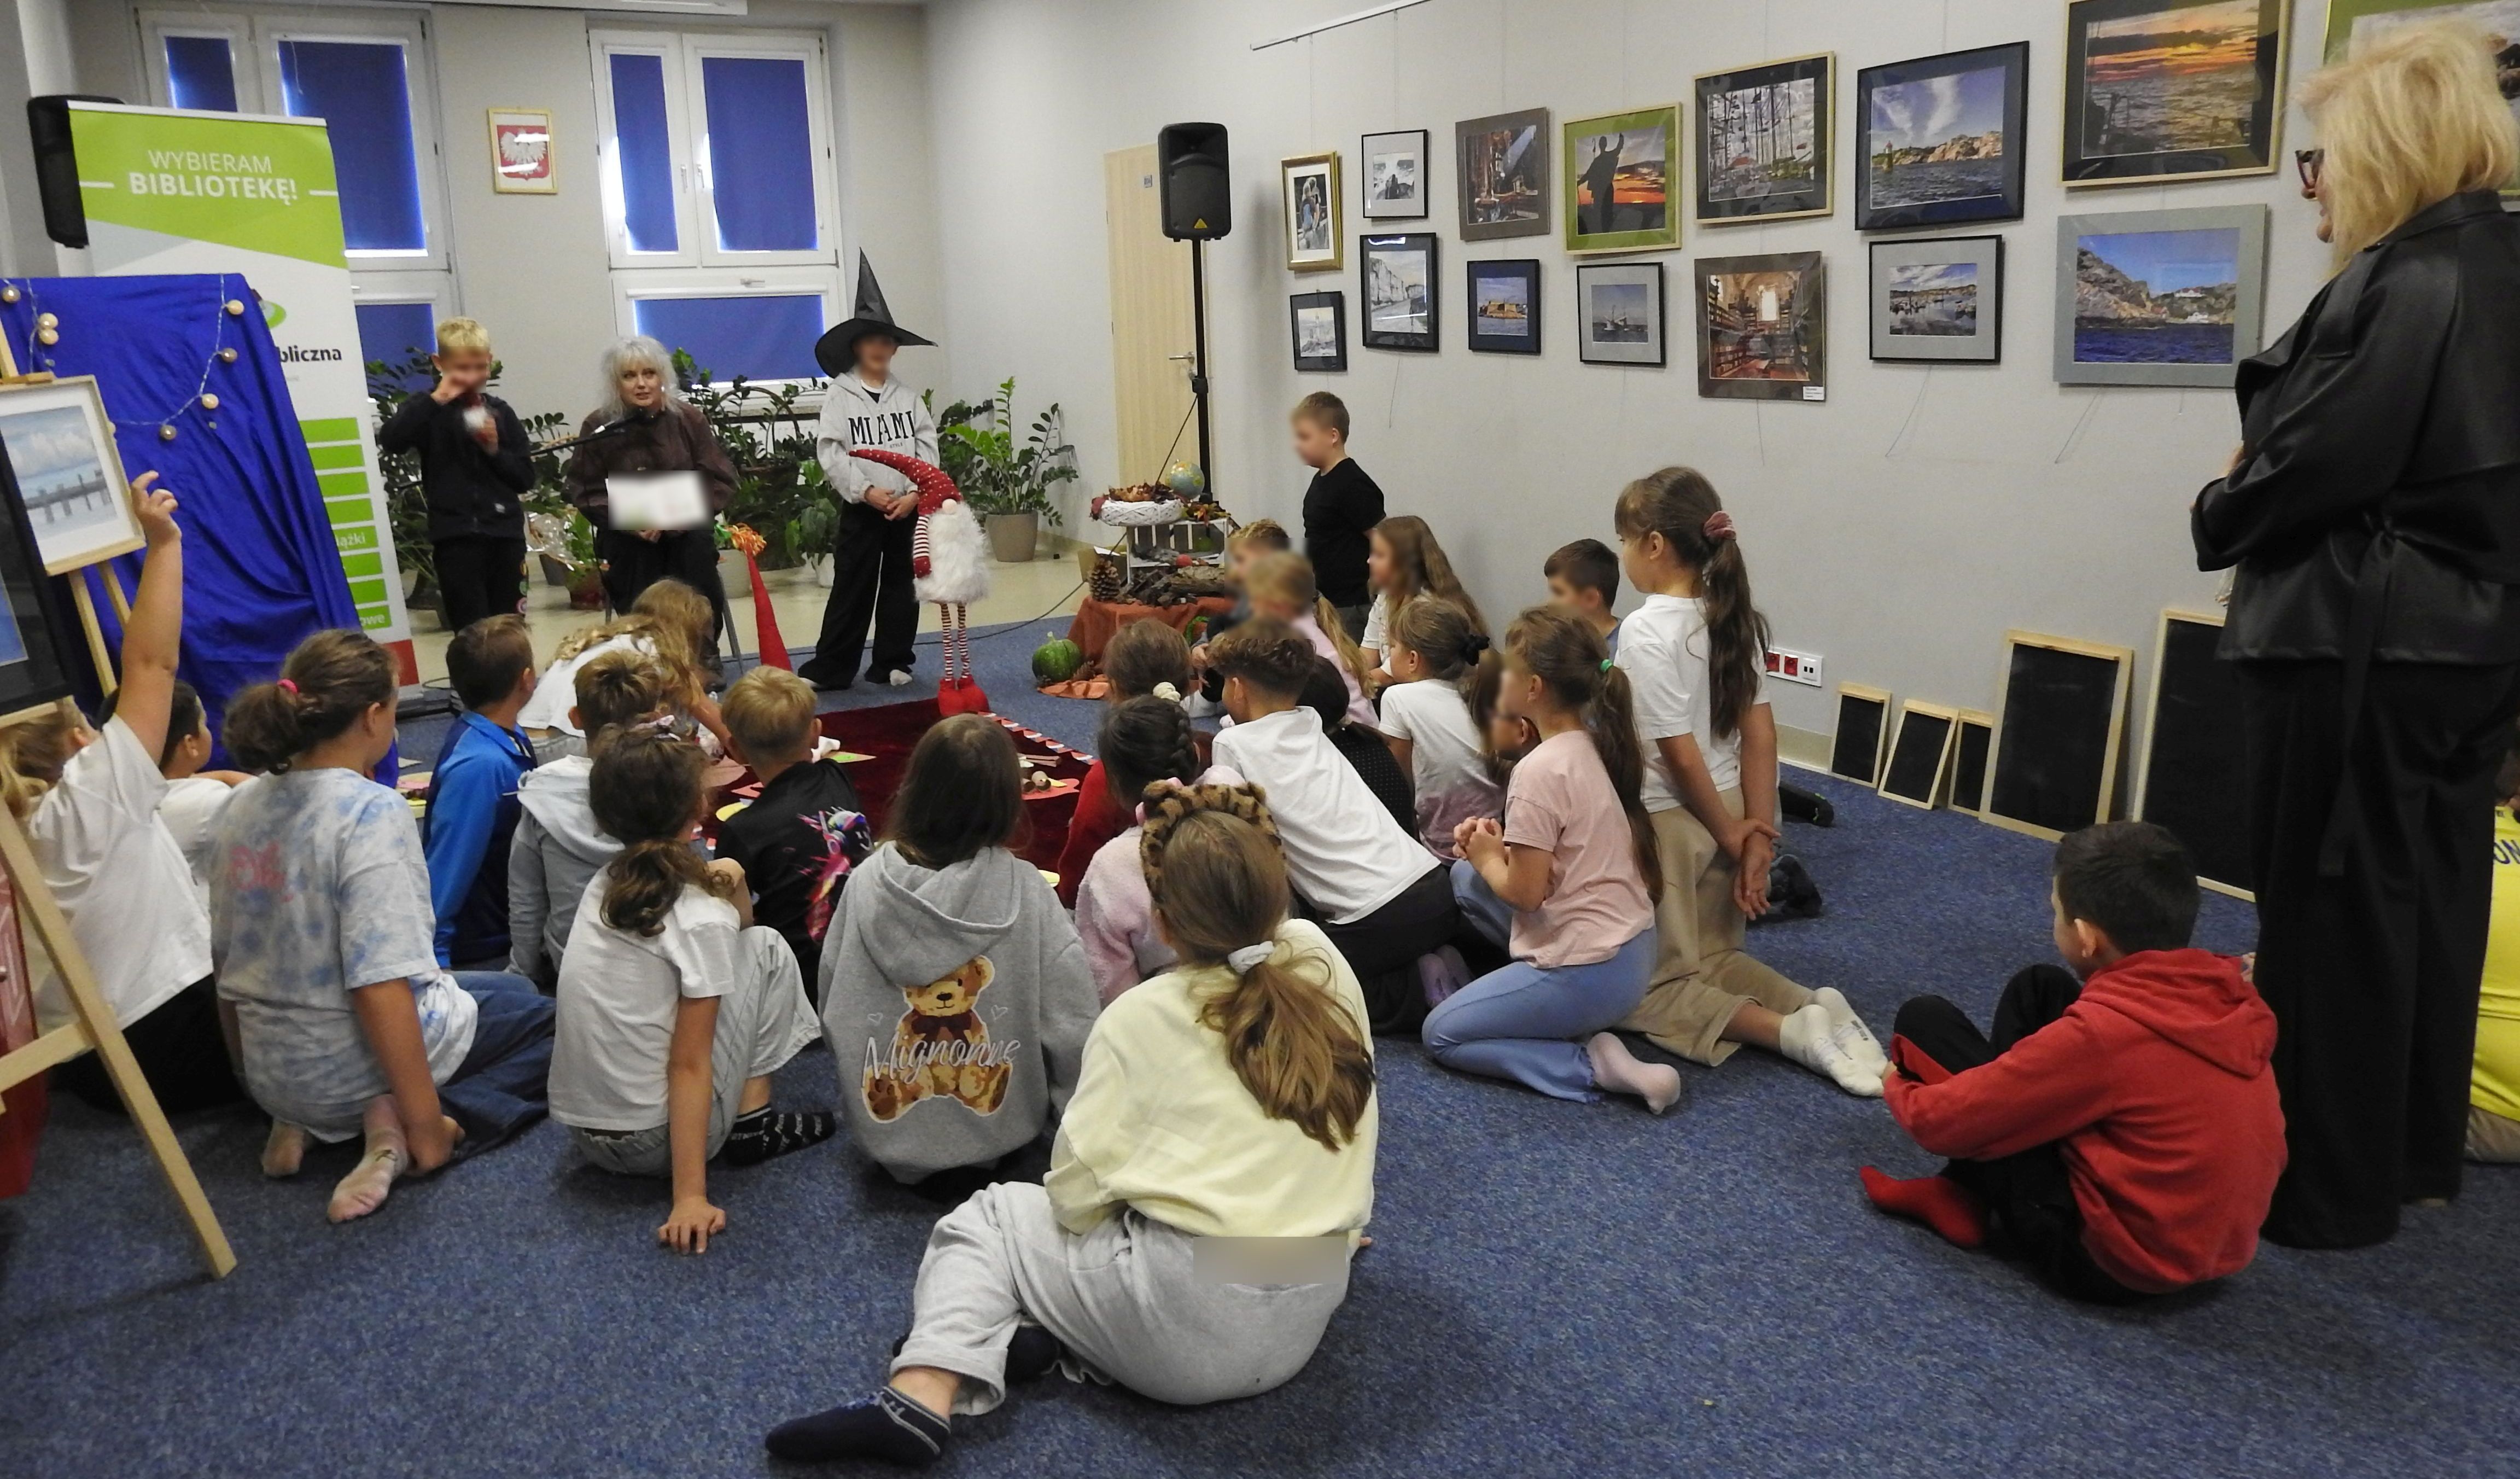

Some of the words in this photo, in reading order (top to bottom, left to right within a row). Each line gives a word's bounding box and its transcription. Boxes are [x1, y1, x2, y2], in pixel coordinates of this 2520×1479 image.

[148, 150, 272, 173] WYBIERAM
[129, 172, 298, 206] BIBLIOTEKĘ!
[848, 411, 915, 445] MIAMI
